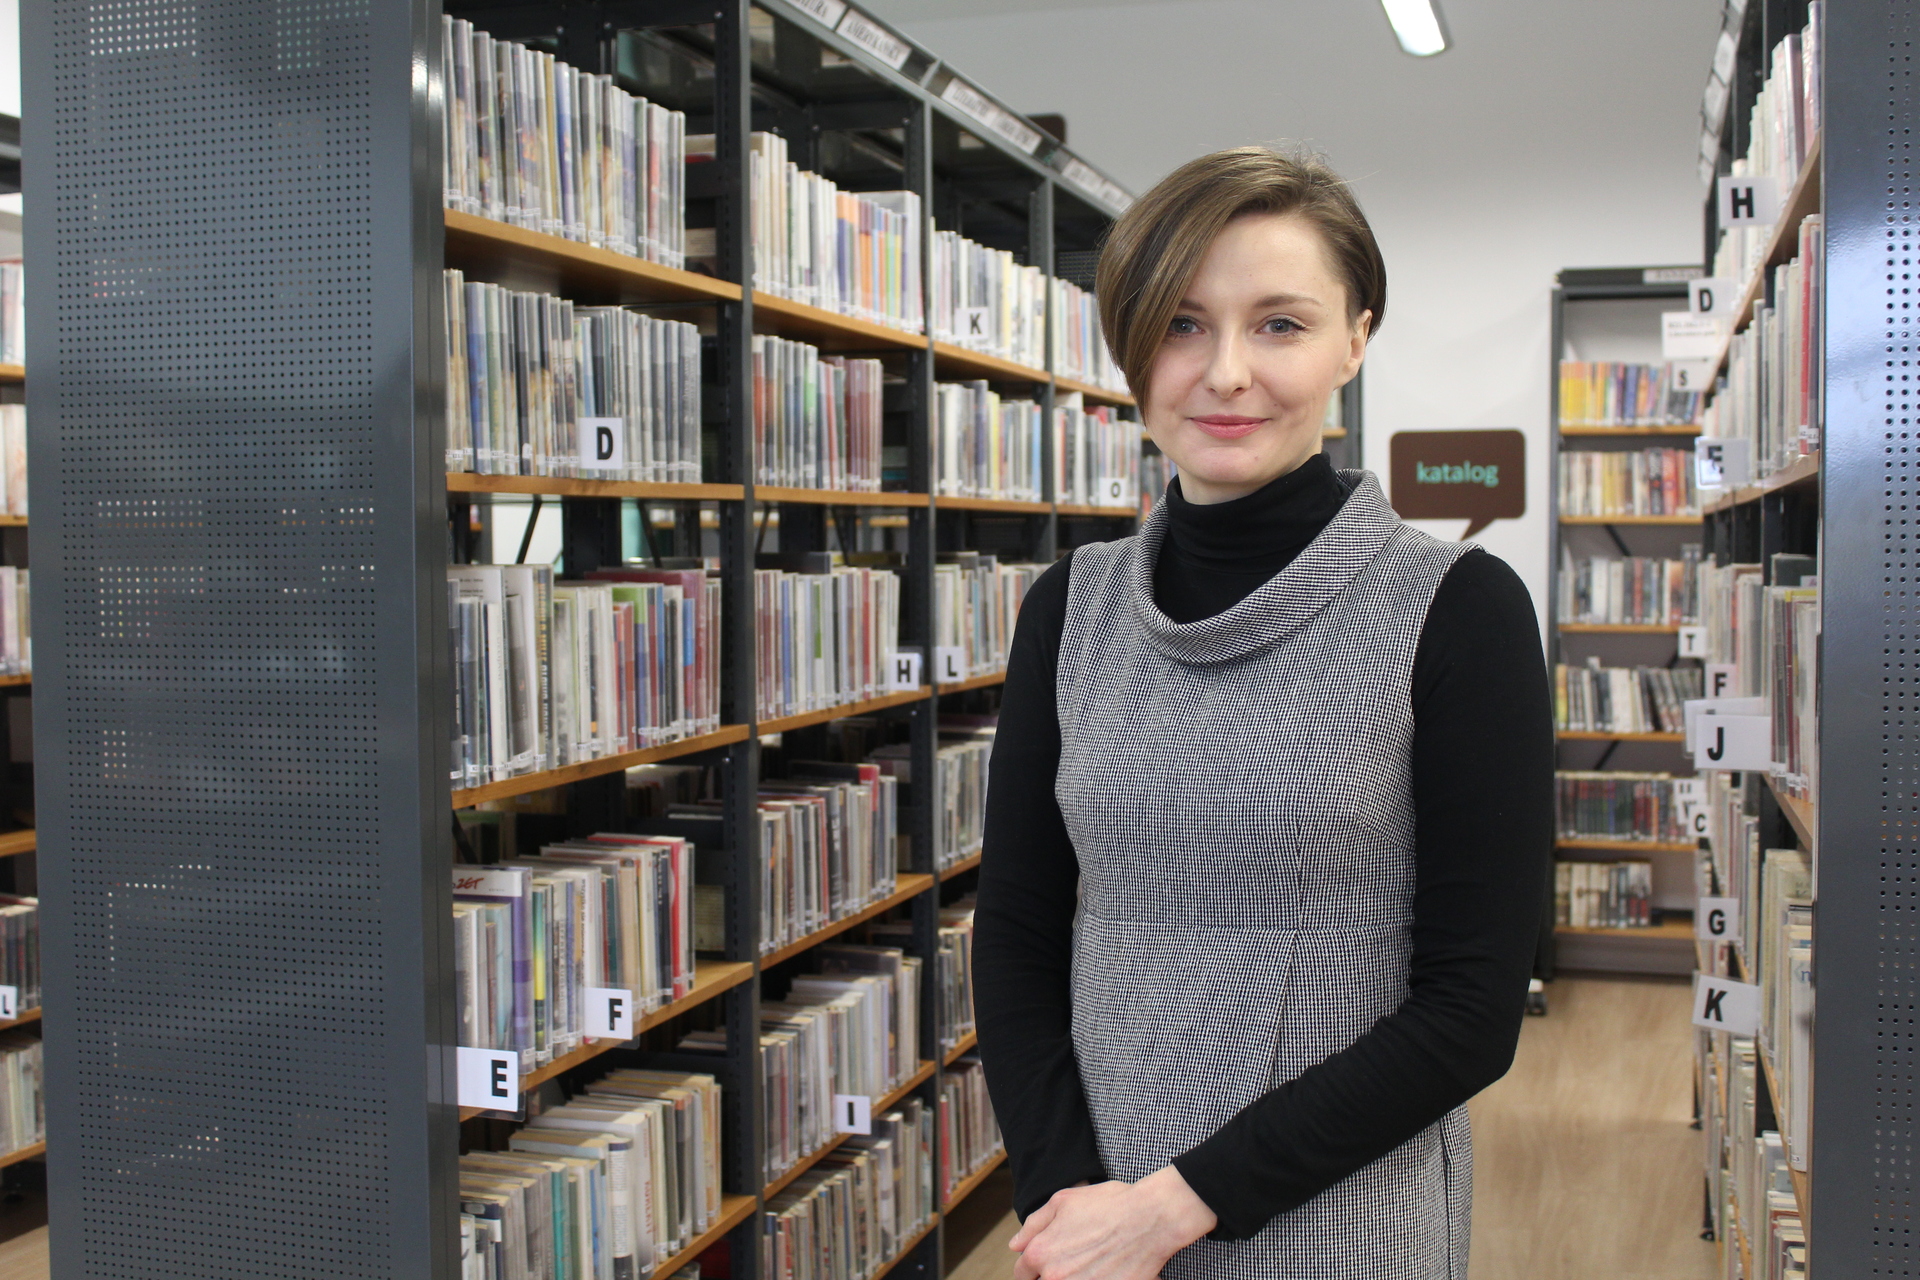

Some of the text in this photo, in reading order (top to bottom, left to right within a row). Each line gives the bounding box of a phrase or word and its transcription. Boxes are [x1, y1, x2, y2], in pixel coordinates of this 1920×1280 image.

[1731, 187, 1754, 218] H
[1699, 288, 1712, 312] D
[970, 313, 982, 335] K
[1679, 369, 1688, 387] S
[597, 426, 613, 460] D
[1416, 460, 1499, 488] katalog
[1686, 634, 1696, 651] T
[898, 660, 910, 682] H
[947, 655, 957, 677] L
[1714, 672, 1727, 697] F
[1707, 727, 1724, 761] J
[1695, 813, 1706, 832] C
[1709, 909, 1725, 935] G
[3, 995, 10, 1014] L
[609, 998, 623, 1031] F
[1704, 988, 1727, 1022] K
[491, 1060, 508, 1097] E
[848, 1102, 854, 1126] I
